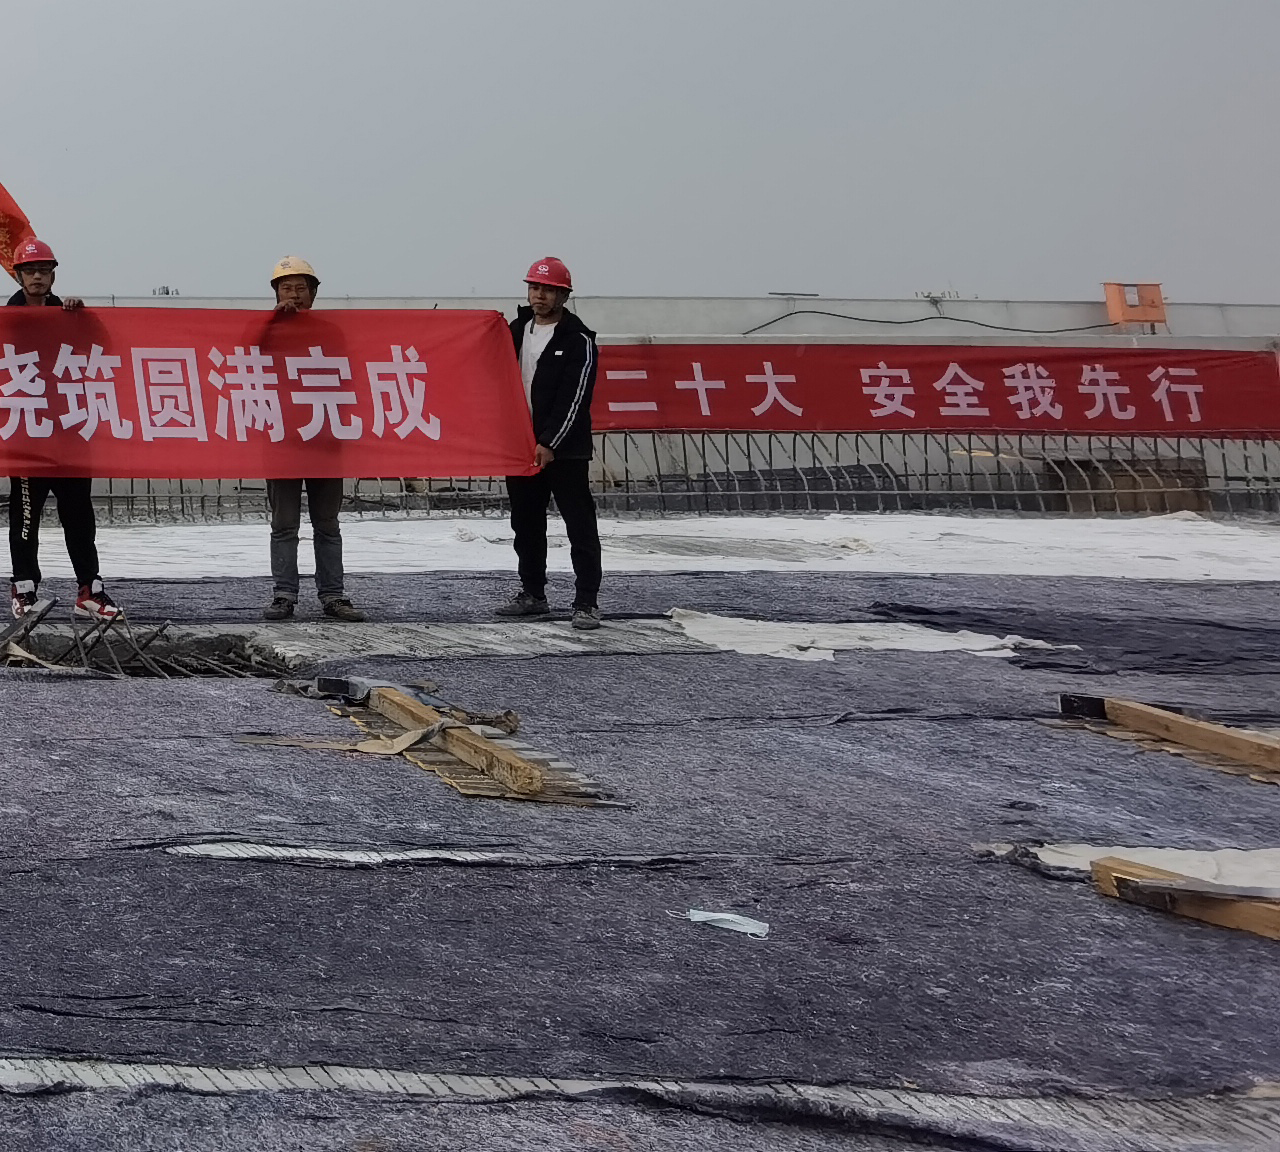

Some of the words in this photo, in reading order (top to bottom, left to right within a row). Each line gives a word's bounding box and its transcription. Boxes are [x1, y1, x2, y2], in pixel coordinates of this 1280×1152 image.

[605, 361, 803, 417] 二十大
[859, 361, 1204, 424] 安全我先行
